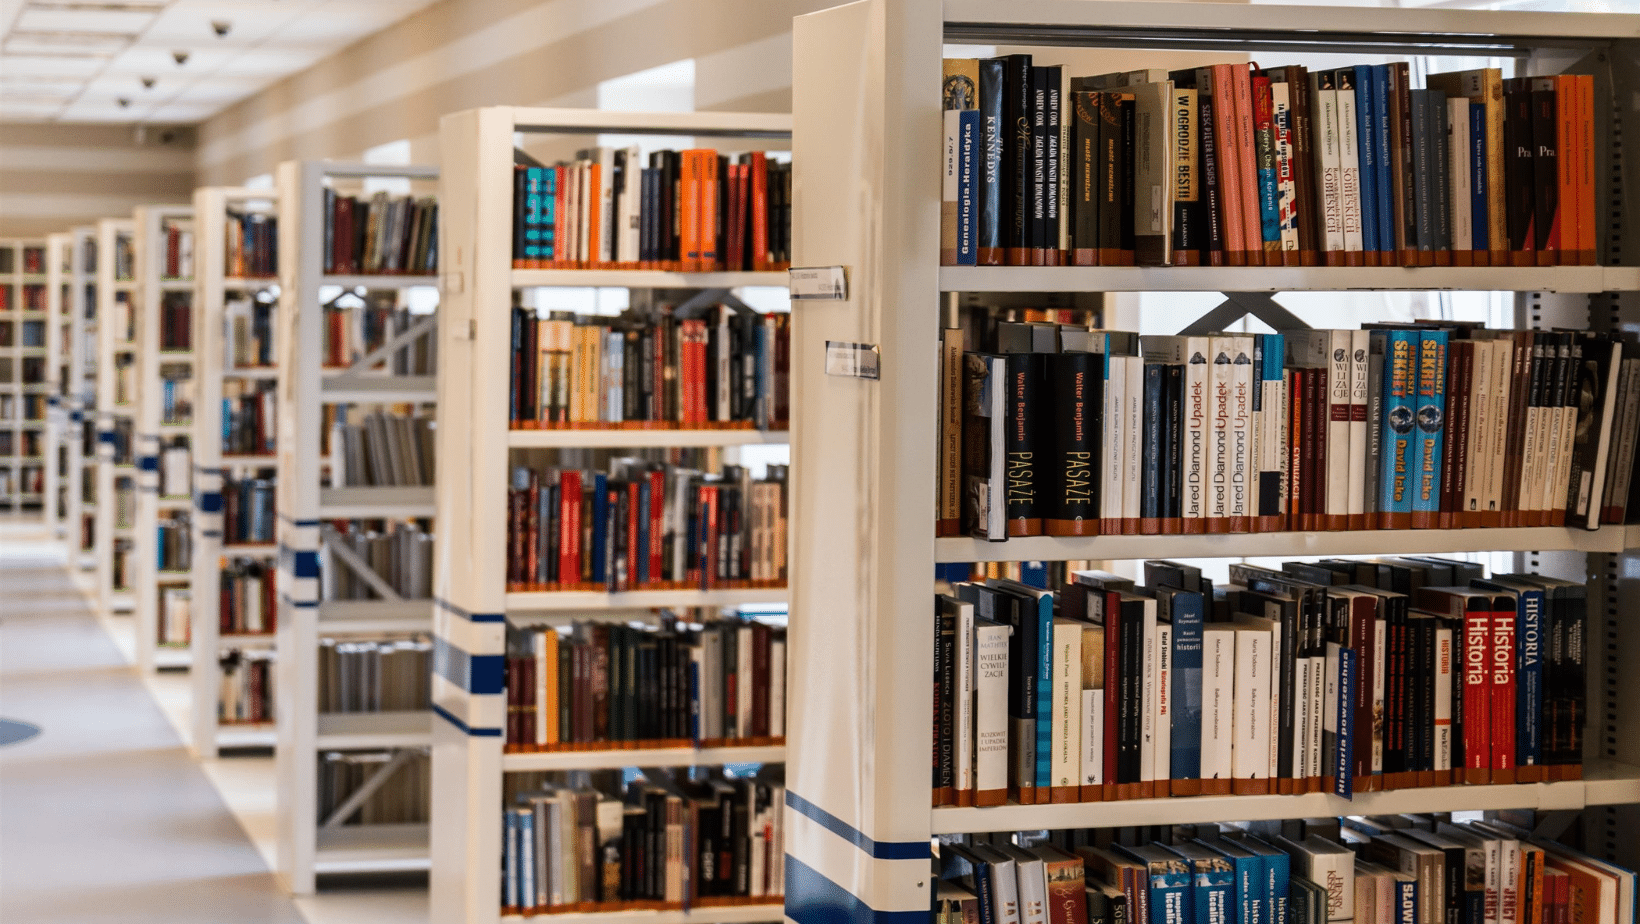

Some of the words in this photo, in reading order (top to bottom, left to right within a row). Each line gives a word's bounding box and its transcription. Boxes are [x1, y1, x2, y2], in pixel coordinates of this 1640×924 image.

[1035, 89, 1045, 110] ANDREW
[1048, 89, 1058, 110] ANDREW
[1178, 96, 1190, 106] W
[1035, 111, 1045, 127] COOK
[1048, 111, 1058, 127] COOK
[1178, 109, 1190, 161] OGRODZIE
[986, 116, 995, 183] KENNEDYS
[1035, 135, 1045, 158] ZAGŁADA
[1048, 135, 1058, 158] ZAGŁADA
[1262, 122, 1271, 152] Fryderyk
[1035, 159, 1045, 183] DYNASTII
[1048, 159, 1058, 183] DYNASTII
[1178, 165, 1190, 198] BESTII
[961, 123, 971, 255] Genealogia.Heraldyka
[1035, 183, 1045, 219] ROMANOWÓW
[1048, 183, 1058, 219] ROMANOWÓW
[1266, 181, 1274, 211] Korzenie
[1324, 167, 1336, 234] SOBIESKICH
[1343, 167, 1355, 234] SOBIESKICH
[1015, 372, 1026, 400] Walter
[1074, 372, 1084, 400] Walter
[1392, 340, 1408, 399] SEKRET
[1420, 339, 1436, 398] SEKRET
[1015, 402, 1026, 442] Benjamin
[1073, 402, 1084, 442] Benjamin
[1191, 381, 1204, 428] Upadek
[1214, 381, 1228, 428] Upadek
[1234, 381, 1249, 428] Upadek
[1372, 396, 1380, 421] OSKAR
[1189, 430, 1201, 483] Diamond
[1213, 430, 1226, 483] Diamond
[1232, 430, 1245, 483] Diamond
[1371, 423, 1379, 456] HALECKI
[1395, 439, 1407, 473] David
[1423, 438, 1435, 471] David
[1008, 451, 1036, 505] PASAŻE
[1065, 451, 1094, 505] PASAŻE
[1293, 447, 1301, 500] CYWILIZACJE
[1394, 475, 1405, 502] Icke
[1422, 474, 1433, 501] Icke
[1189, 485, 1201, 518] Jared
[1213, 485, 1224, 518] Jared
[1233, 485, 1244, 518] Jared
[1525, 597, 1539, 666] HISTORIA
[944, 642, 952, 664] SILVIA
[1441, 639, 1449, 674] HISTORIA
[1468, 617, 1489, 685] Historia
[1493, 617, 1514, 685] Historia
[1341, 652, 1349, 736] powszechna
[1338, 738, 1347, 793] Historia
[1335, 877, 1344, 909] HENRY
[1402, 884, 1414, 924] SŁOW
